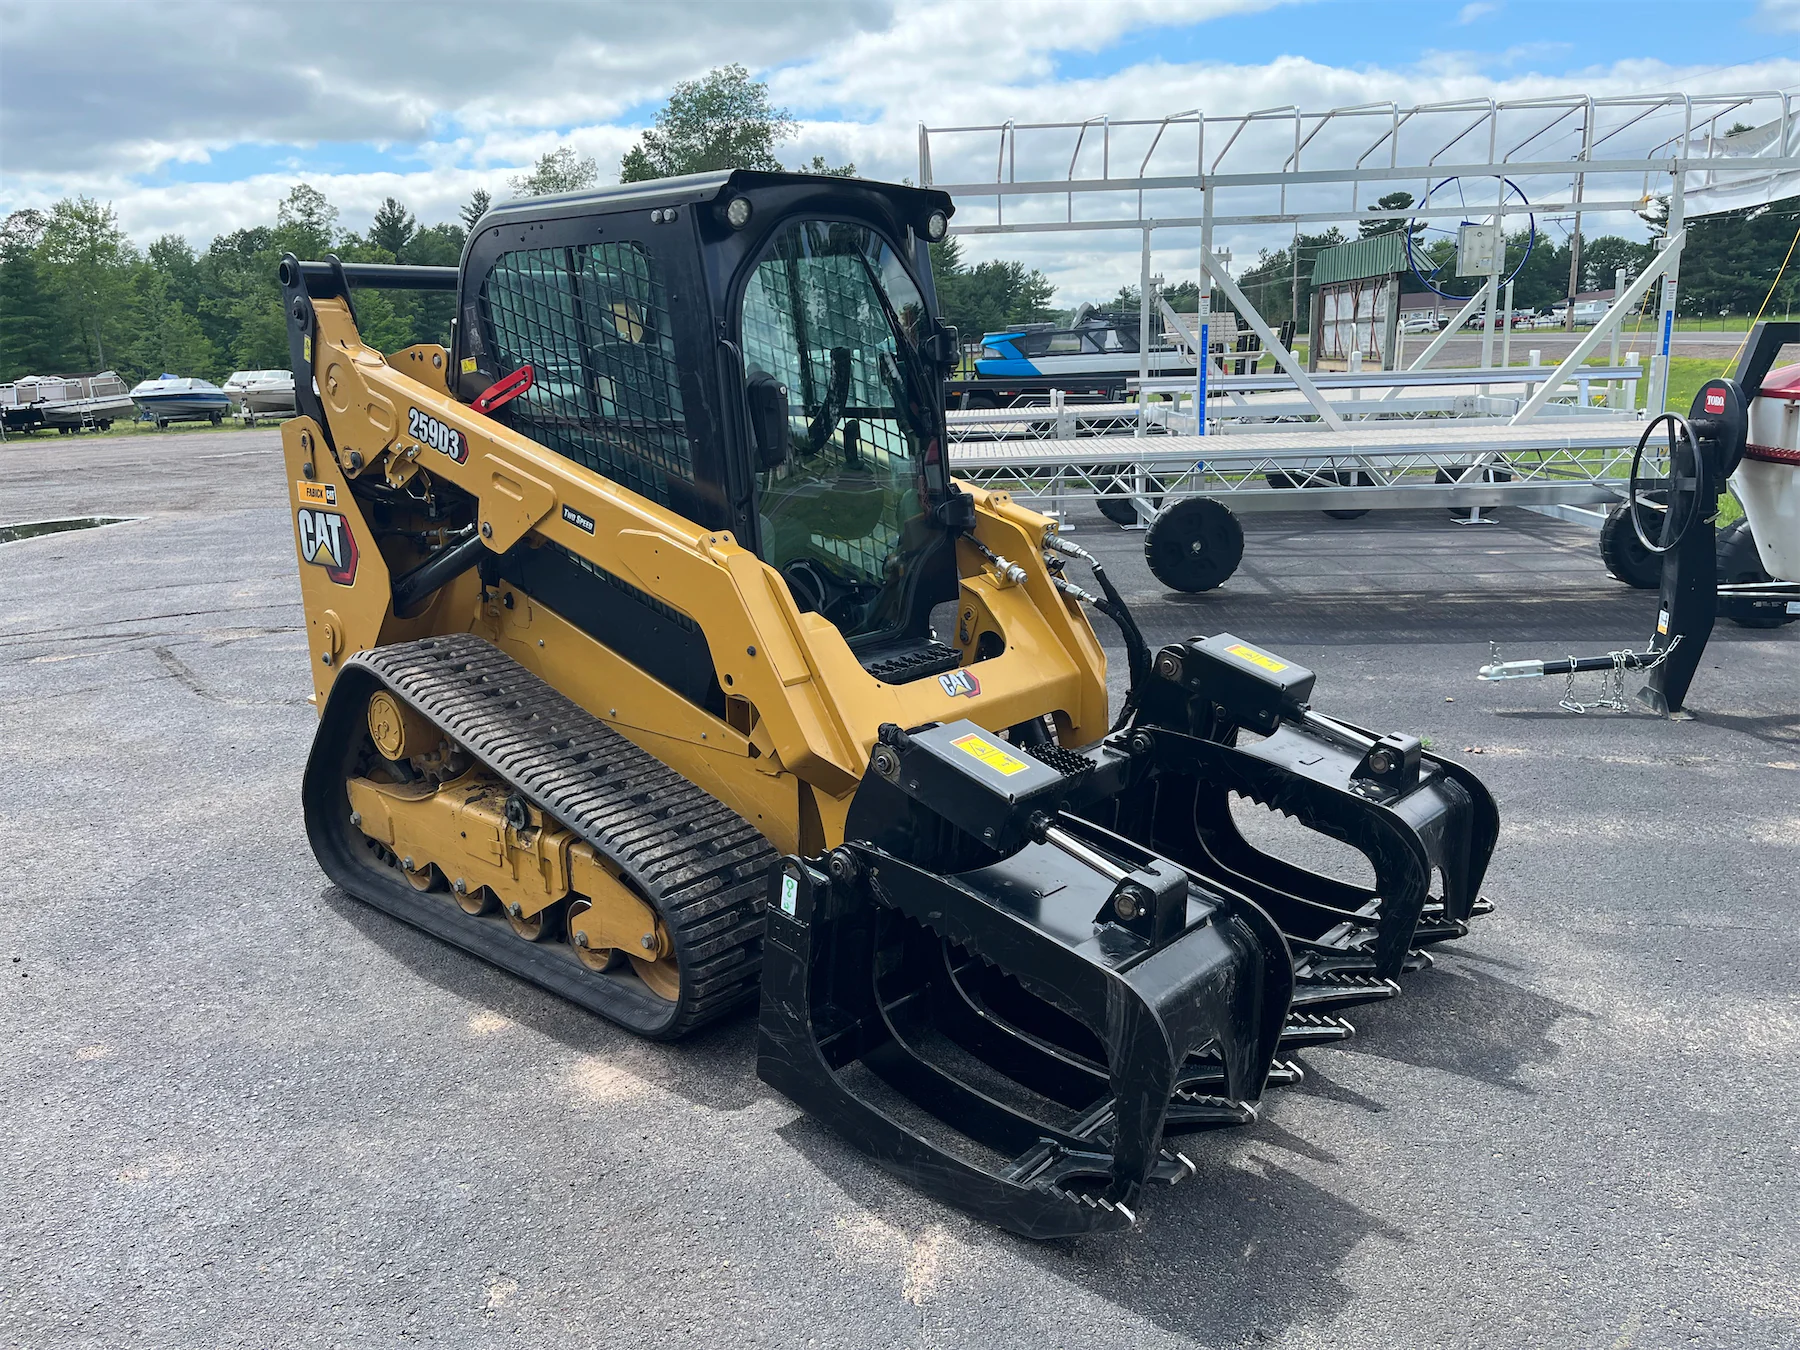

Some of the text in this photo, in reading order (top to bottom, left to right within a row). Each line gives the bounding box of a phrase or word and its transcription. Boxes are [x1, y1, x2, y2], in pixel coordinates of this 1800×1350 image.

[1706, 395, 1725, 407] TORO
[409, 407, 460, 460] 259D3
[298, 509, 343, 568] CAT
[938, 670, 973, 697] CAT
